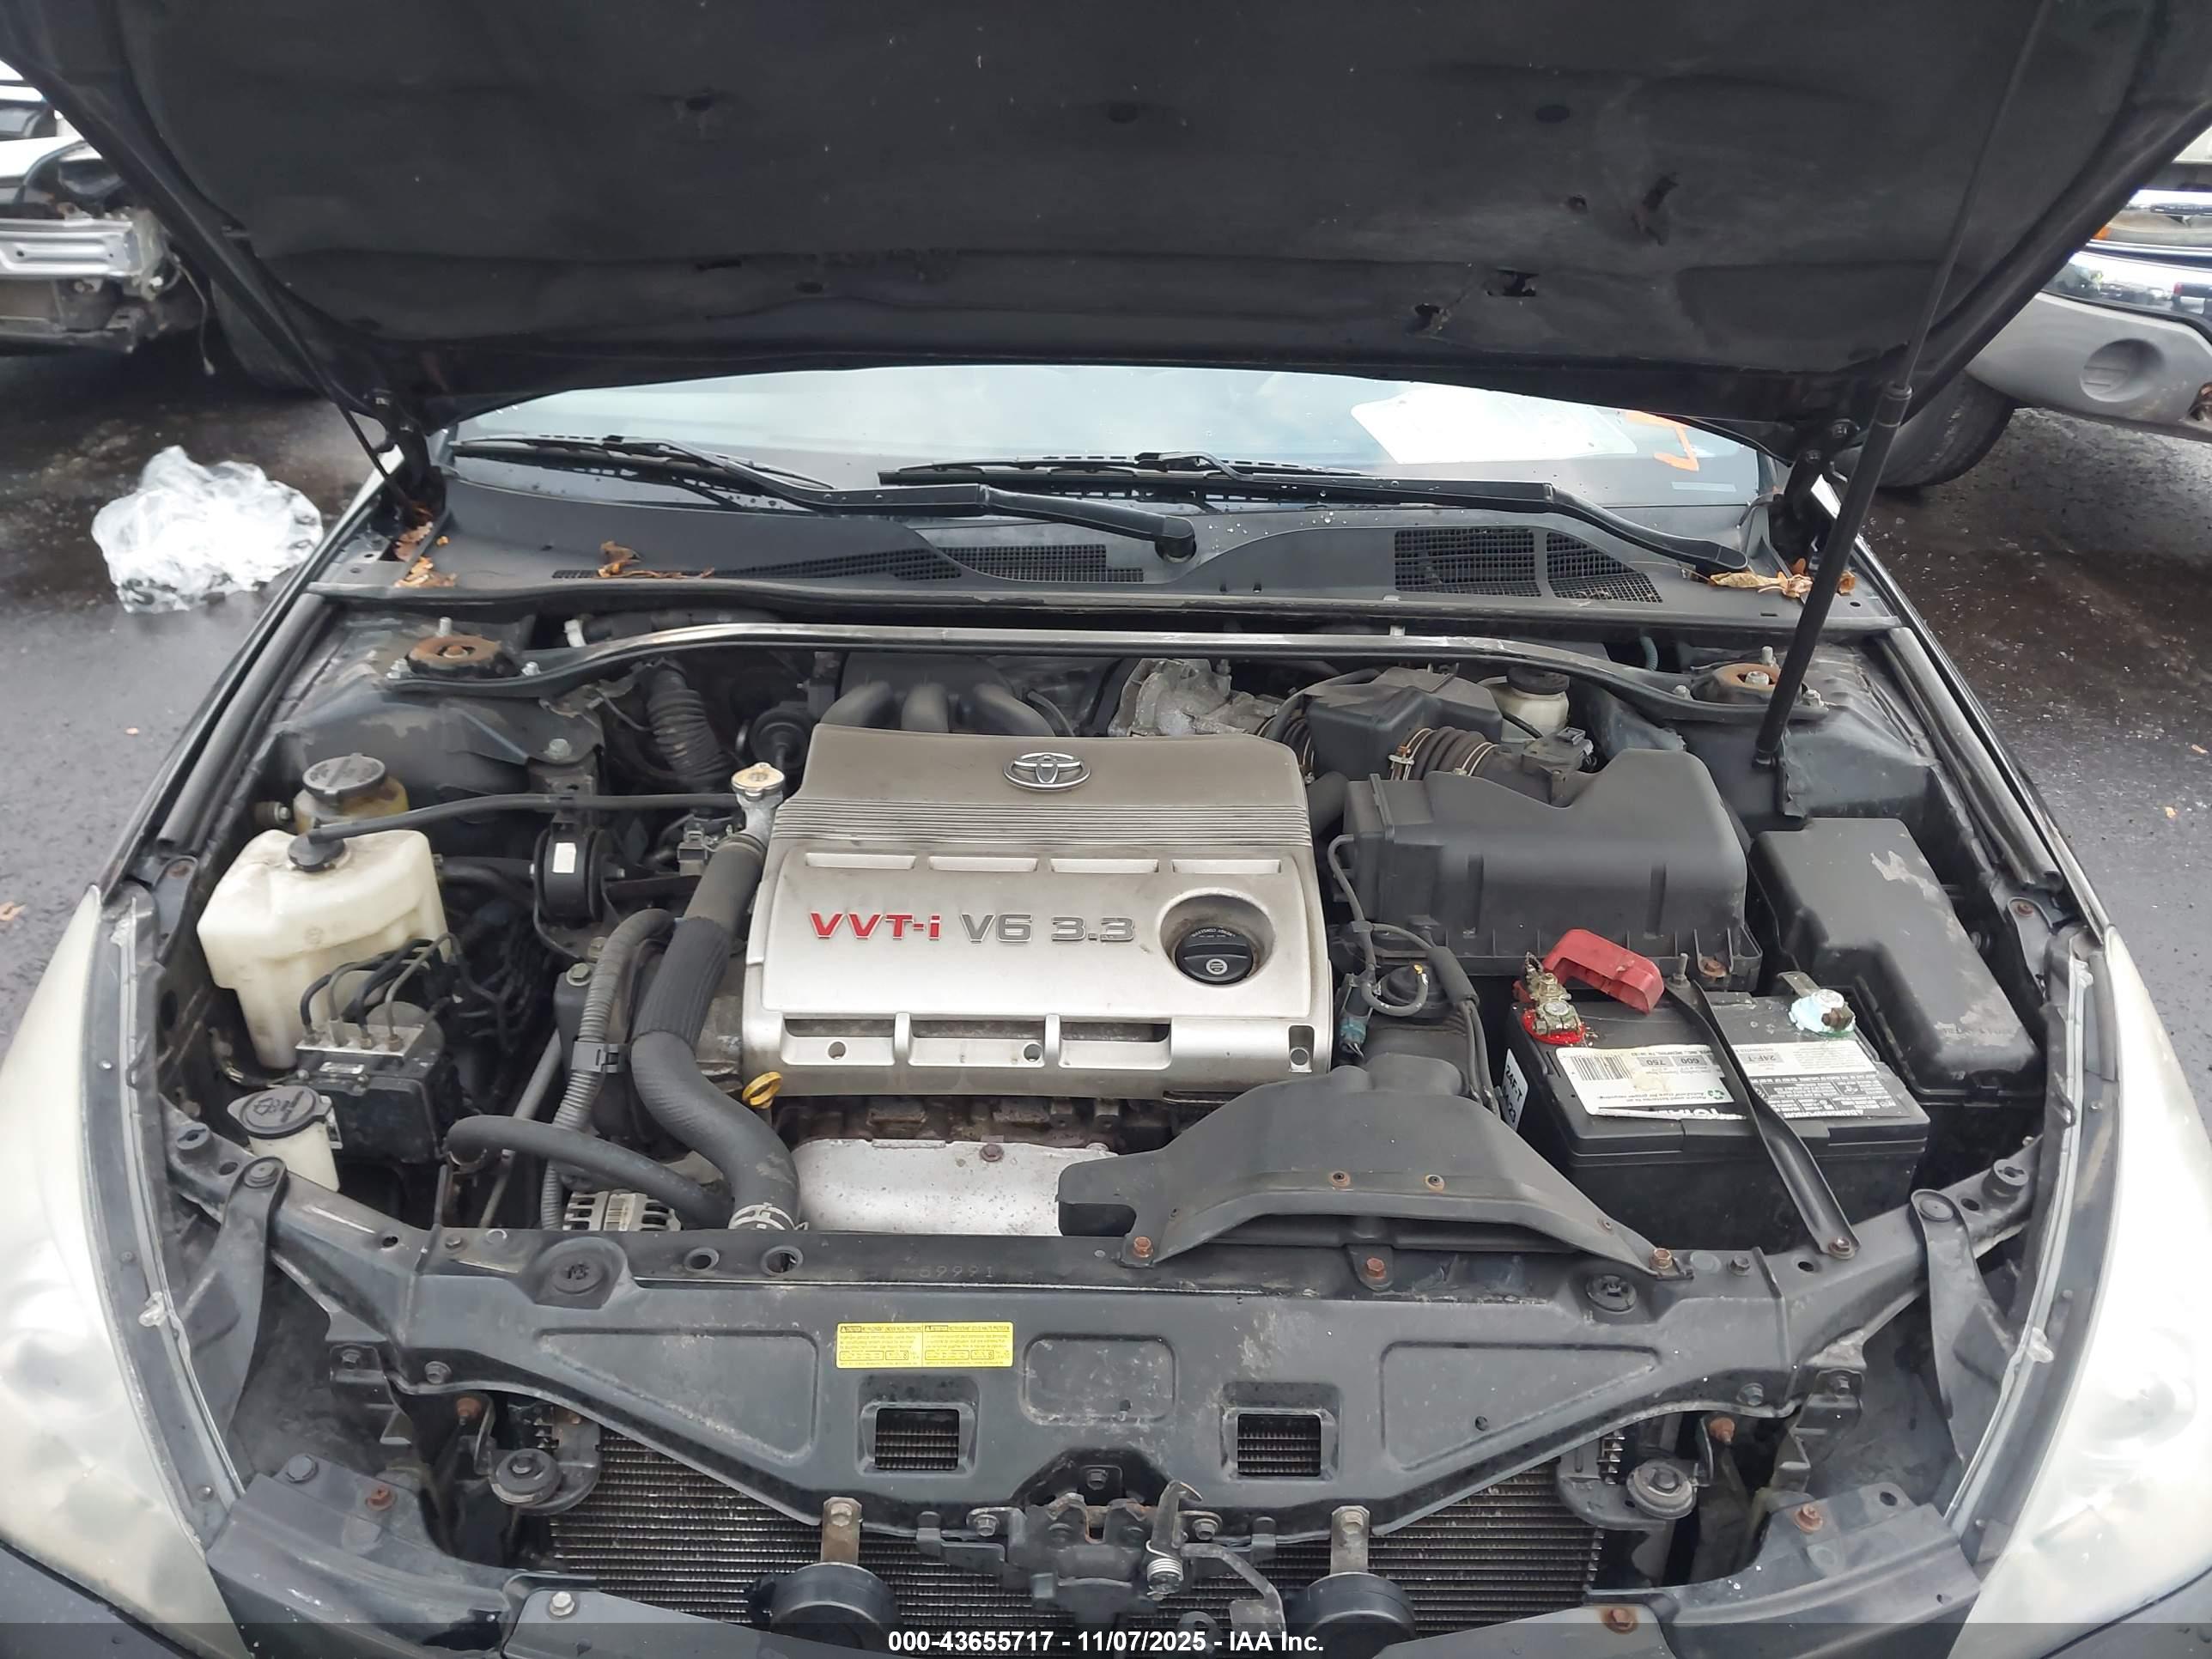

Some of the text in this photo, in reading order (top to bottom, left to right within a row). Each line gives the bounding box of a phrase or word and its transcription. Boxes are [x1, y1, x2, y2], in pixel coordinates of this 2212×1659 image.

[810, 912, 1135, 944] VVT-i V6 3.3
[1747, 1054, 1777, 1062] 24F-T
